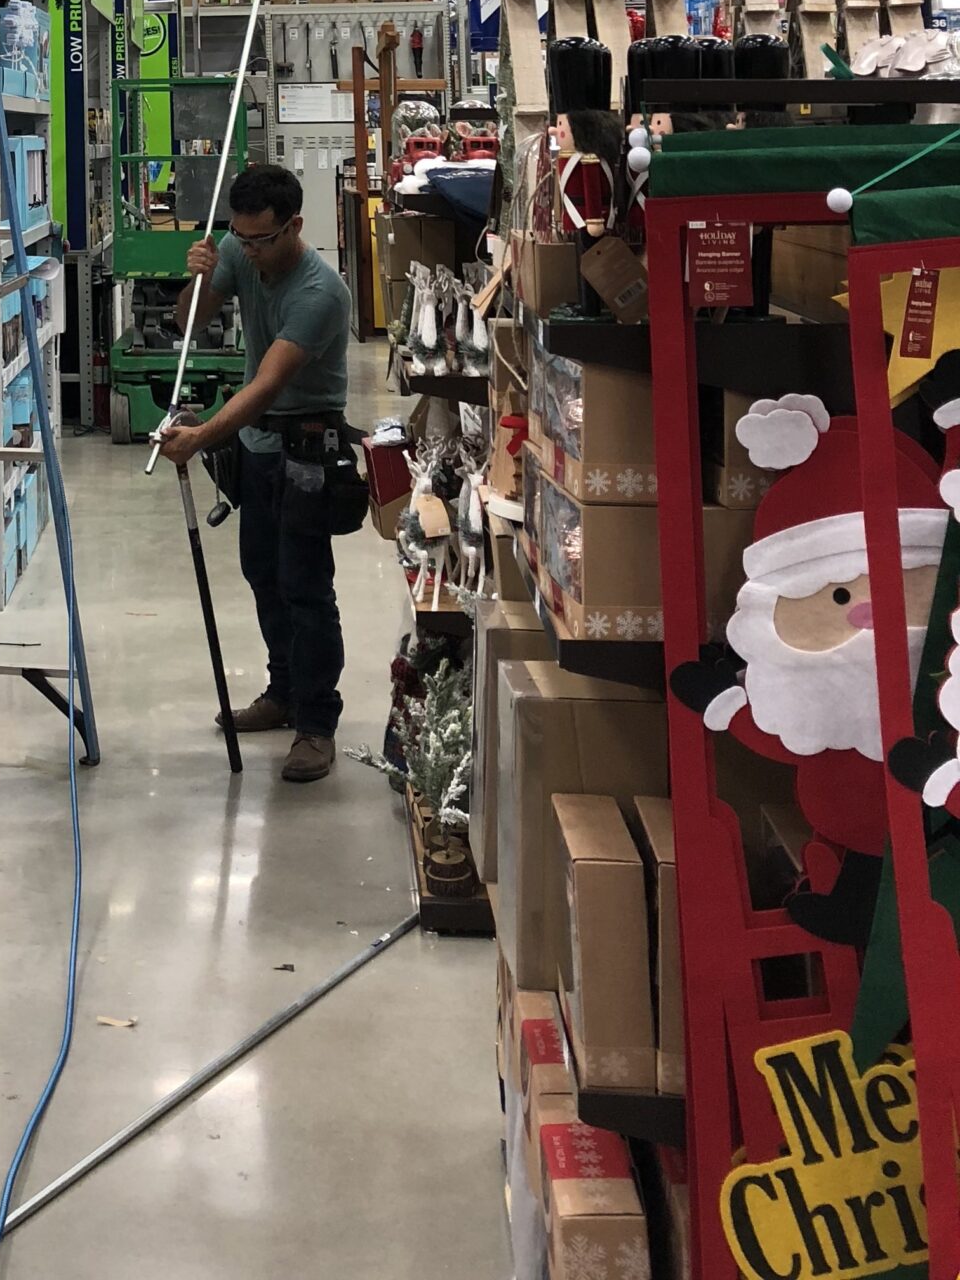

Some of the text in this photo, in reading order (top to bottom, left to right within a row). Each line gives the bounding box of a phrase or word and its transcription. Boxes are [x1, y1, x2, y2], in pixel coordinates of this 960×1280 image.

[932, 20, 947, 28] 36
[115, 13, 125, 61] PRICES!
[70, 36, 82, 72] LOW
[699, 231, 737, 240] HOLIDAY
